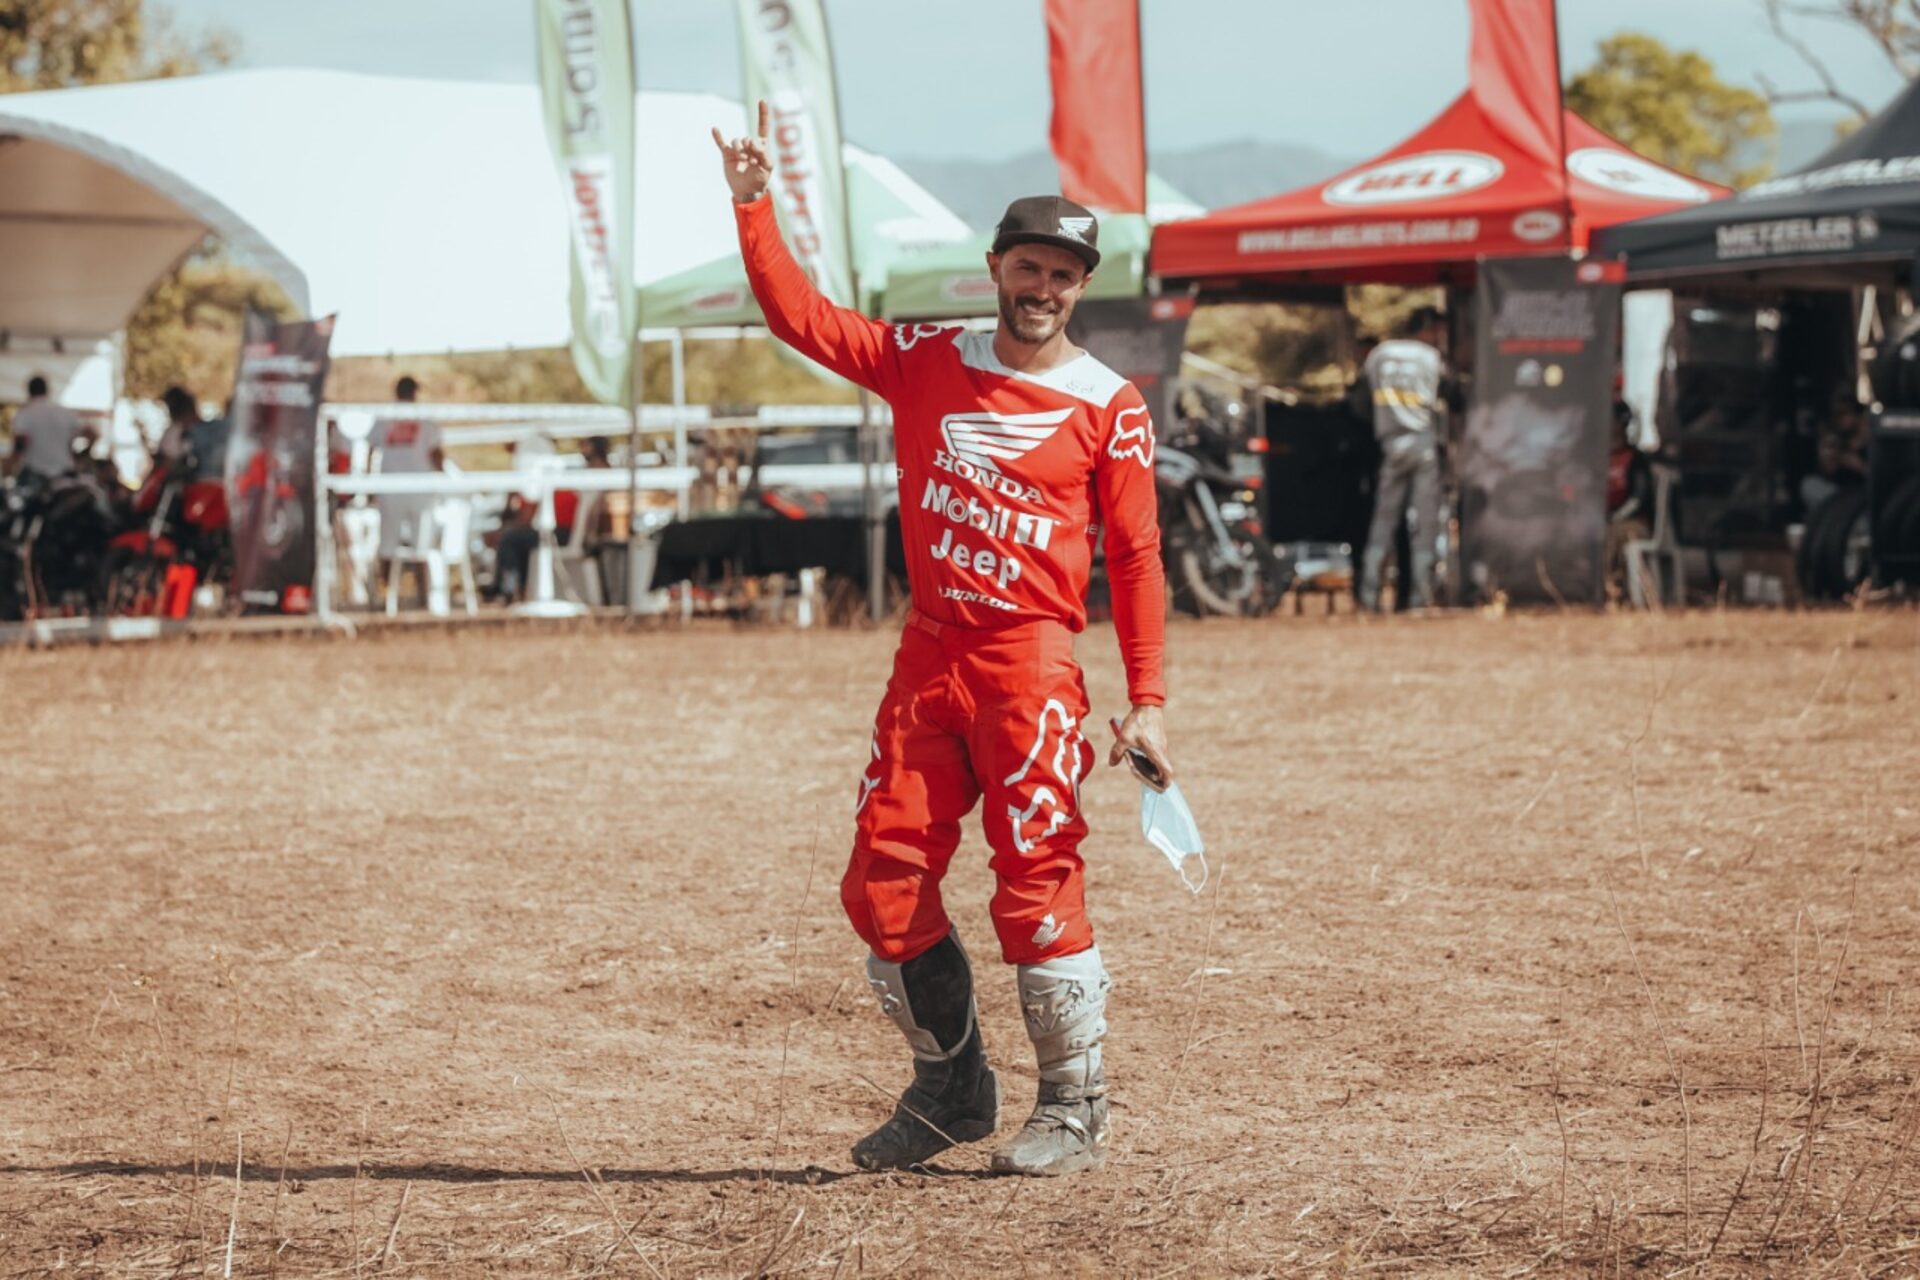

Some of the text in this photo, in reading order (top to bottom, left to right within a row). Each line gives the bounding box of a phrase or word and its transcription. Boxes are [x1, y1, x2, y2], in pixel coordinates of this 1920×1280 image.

[933, 450, 1046, 506] HONDA
[921, 478, 1011, 540] Mobil
[931, 529, 1022, 589] Jeep
